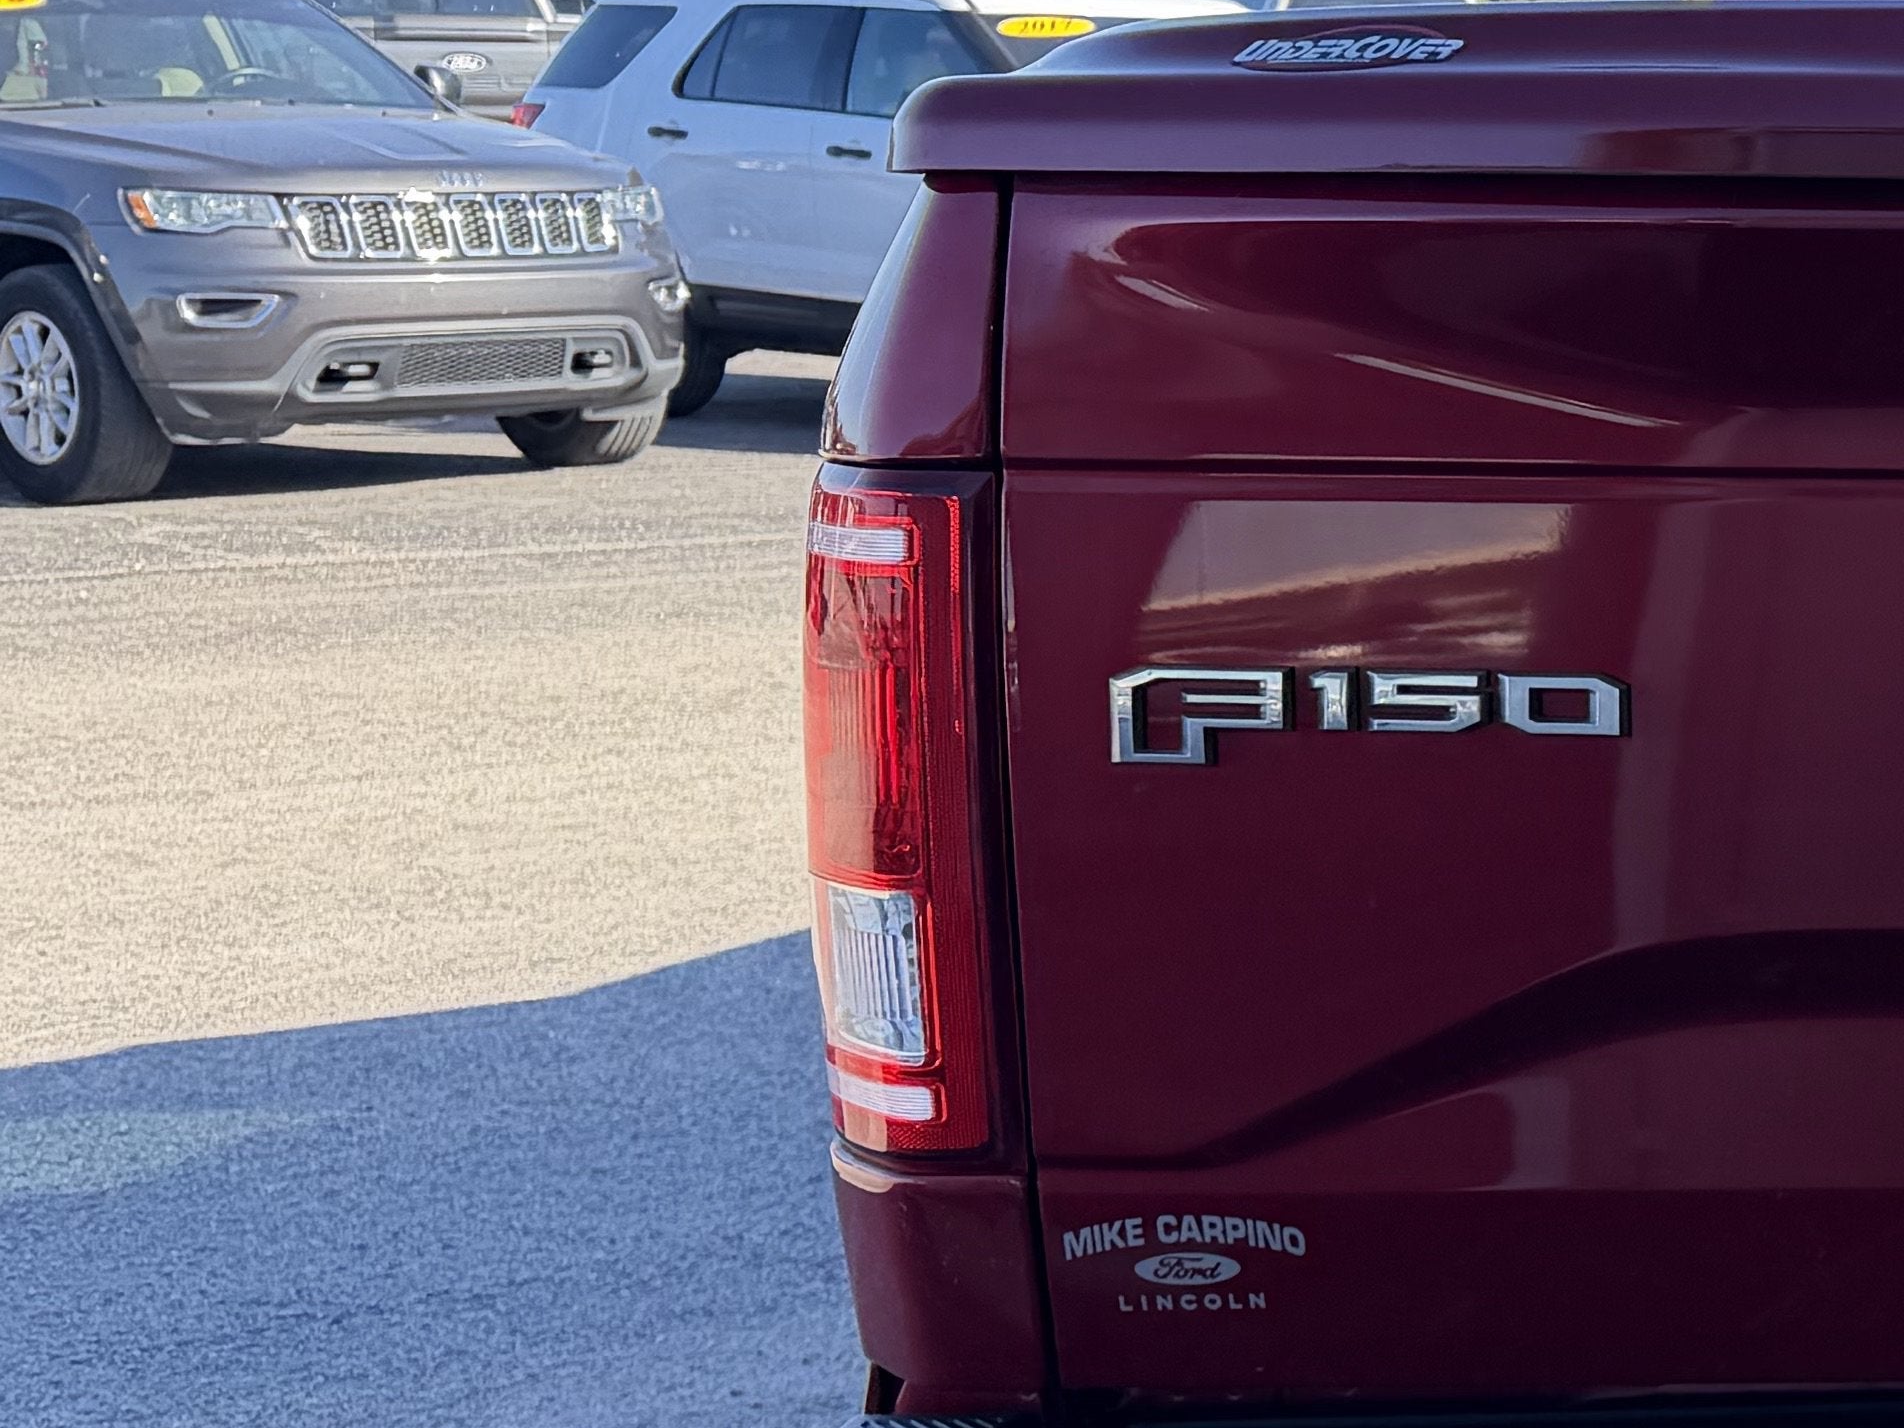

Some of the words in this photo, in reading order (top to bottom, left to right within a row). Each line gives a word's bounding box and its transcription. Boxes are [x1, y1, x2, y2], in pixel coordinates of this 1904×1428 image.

[1062, 1216, 1146, 1261] MIKE
[1156, 1214, 1306, 1257] CARPINO
[1152, 1256, 1223, 1280] Ford
[1117, 1292, 1267, 1312] LINCOLN
